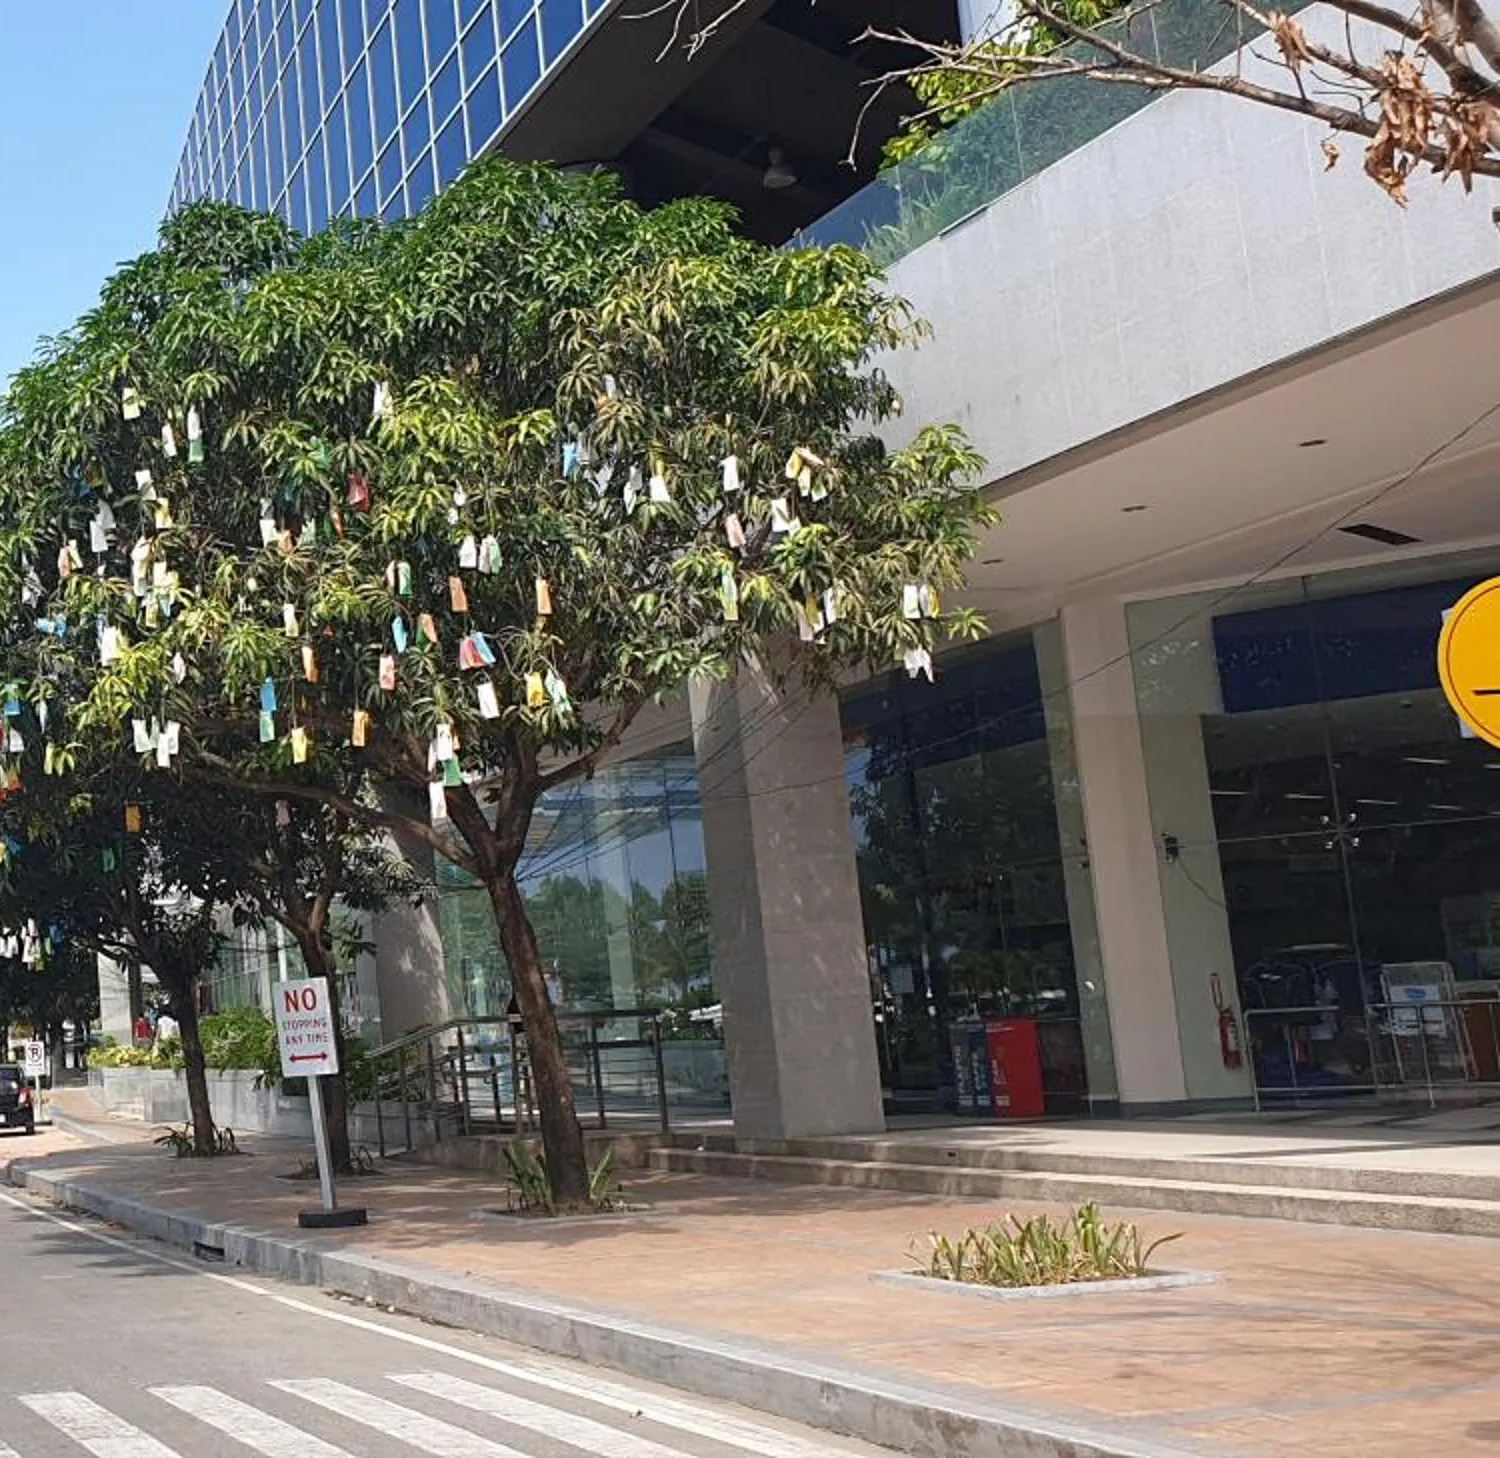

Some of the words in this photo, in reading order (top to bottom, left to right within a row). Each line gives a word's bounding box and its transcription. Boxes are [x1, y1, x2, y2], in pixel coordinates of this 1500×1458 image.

[284, 987, 317, 1012] NO
[282, 1019, 327, 1030] STOPPING
[285, 1034, 304, 1045] ANY
[307, 1032, 329, 1043] TIME
